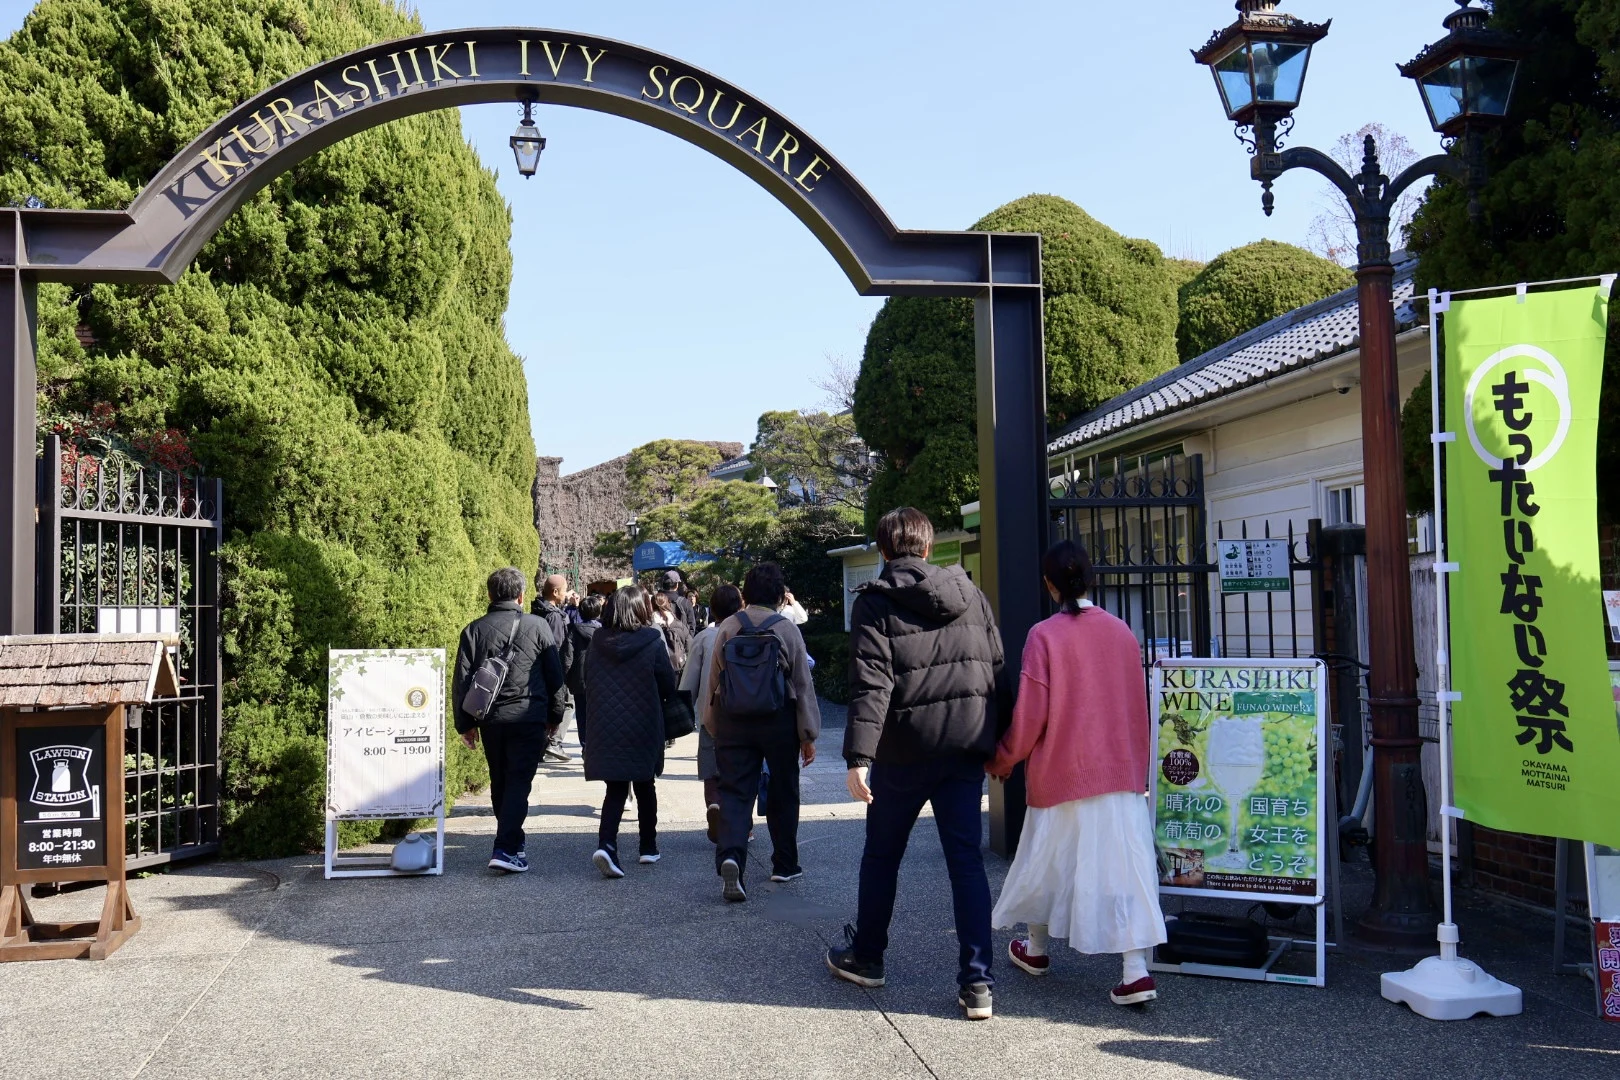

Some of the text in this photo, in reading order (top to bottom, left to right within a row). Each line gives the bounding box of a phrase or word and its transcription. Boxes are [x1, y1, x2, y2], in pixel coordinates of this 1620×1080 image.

[200, 39, 831, 193] KURASHIKI IVY SQUARE
[1488, 370, 1574, 755] もったいない祭
[1161, 669, 1316, 689] KURASHIKI
[1160, 691, 1231, 711] WINE
[1236, 703, 1313, 712] FUNAO WINERY
[343, 726, 429, 737] アイビーショップ
[35, 749, 87, 761] LAWSON
[363, 747, 386, 756] 8:00
[403, 746, 431, 755] 19:00
[1170, 758, 1192, 766] 100%
[1522, 760, 1568, 773] OKAYAMA
[1521, 769, 1571, 783] MOTTAINAI
[1526, 779, 1566, 791] MATSURI
[36, 790, 87, 802] STATION
[1166, 793, 1308, 816] 晴れの 国育ち
[42, 828, 82, 838] 営業時間
[1165, 819, 1308, 844] 葡萄の 女王を
[42, 853, 82, 864] 年中無休
[1248, 853, 1308, 874] どうぞ
